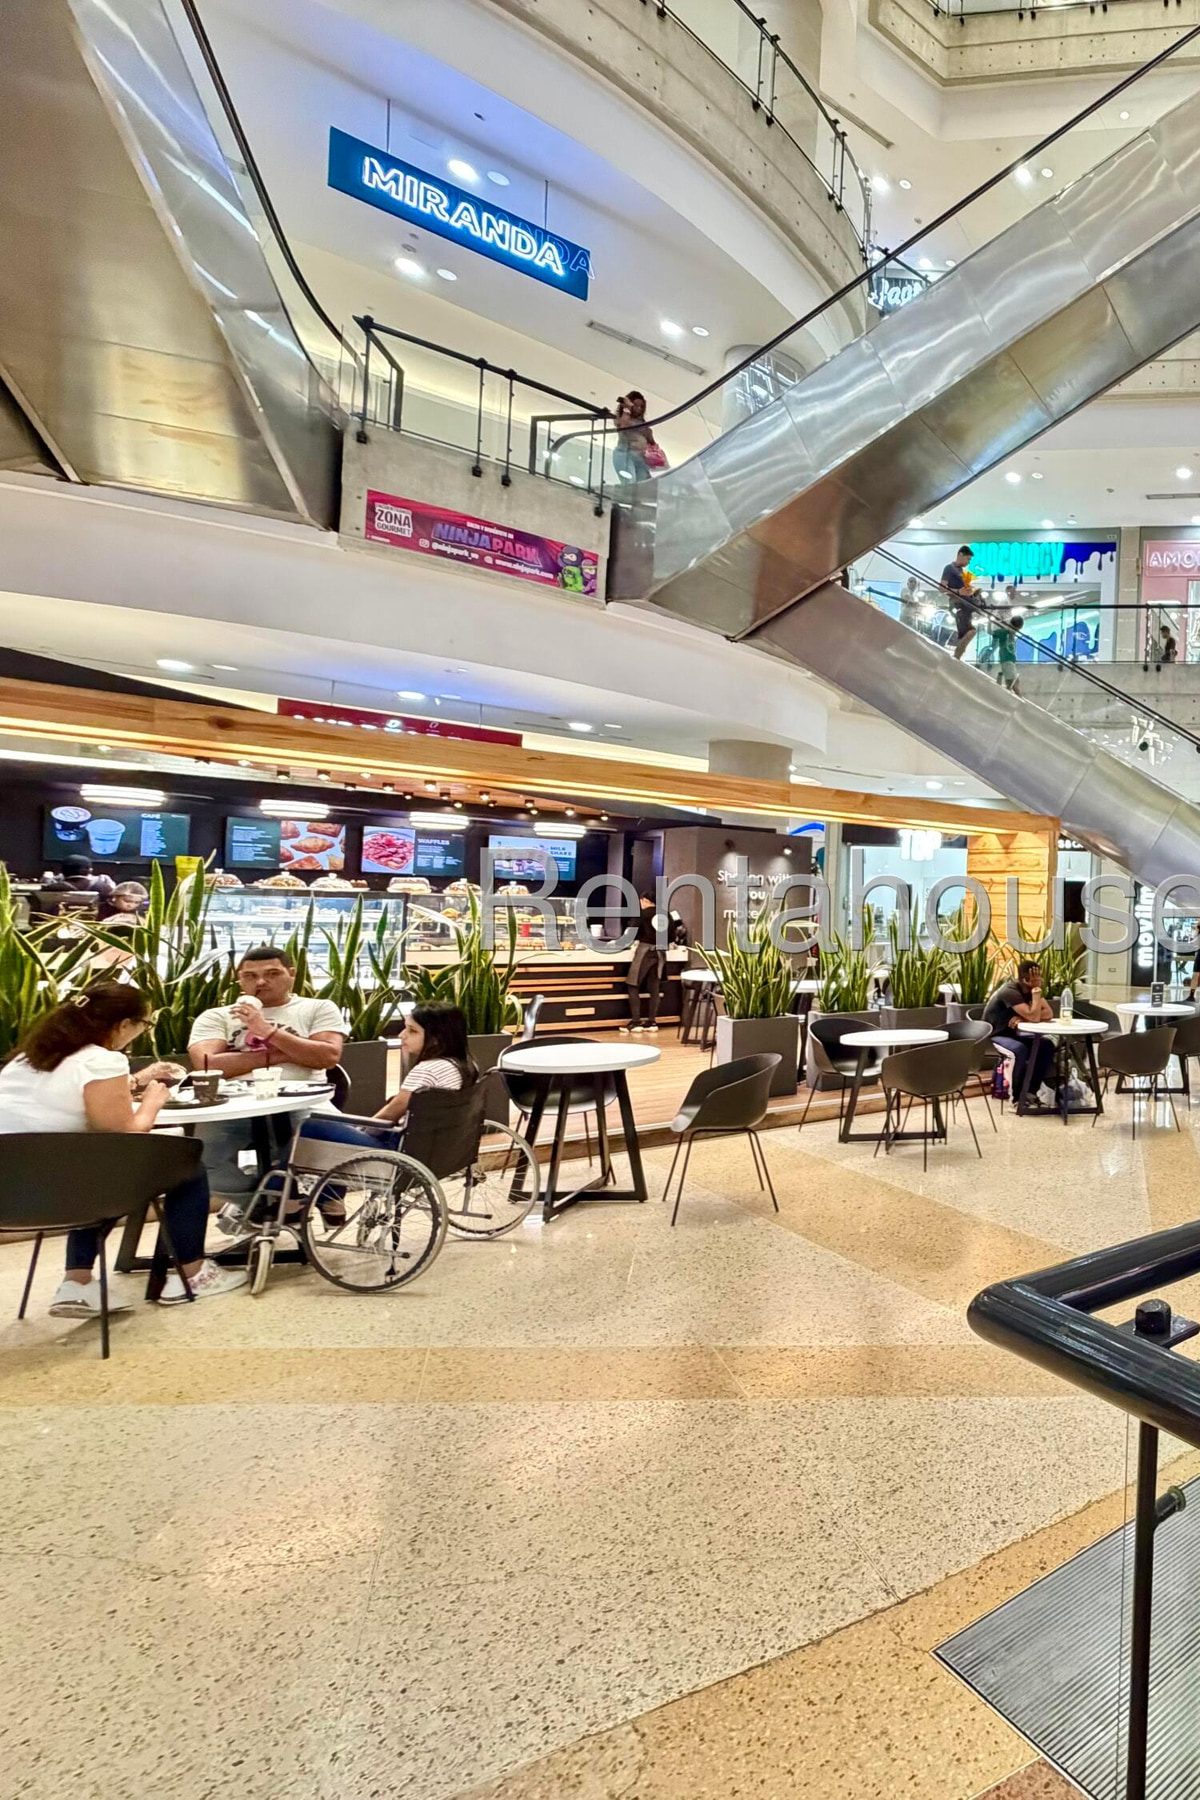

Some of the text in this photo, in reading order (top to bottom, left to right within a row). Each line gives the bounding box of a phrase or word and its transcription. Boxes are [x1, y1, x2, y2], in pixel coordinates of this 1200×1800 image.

[362, 155, 565, 277] MIRANDA
[377, 509, 411, 528] ZONA
[434, 523, 540, 564] NINJA PARK
